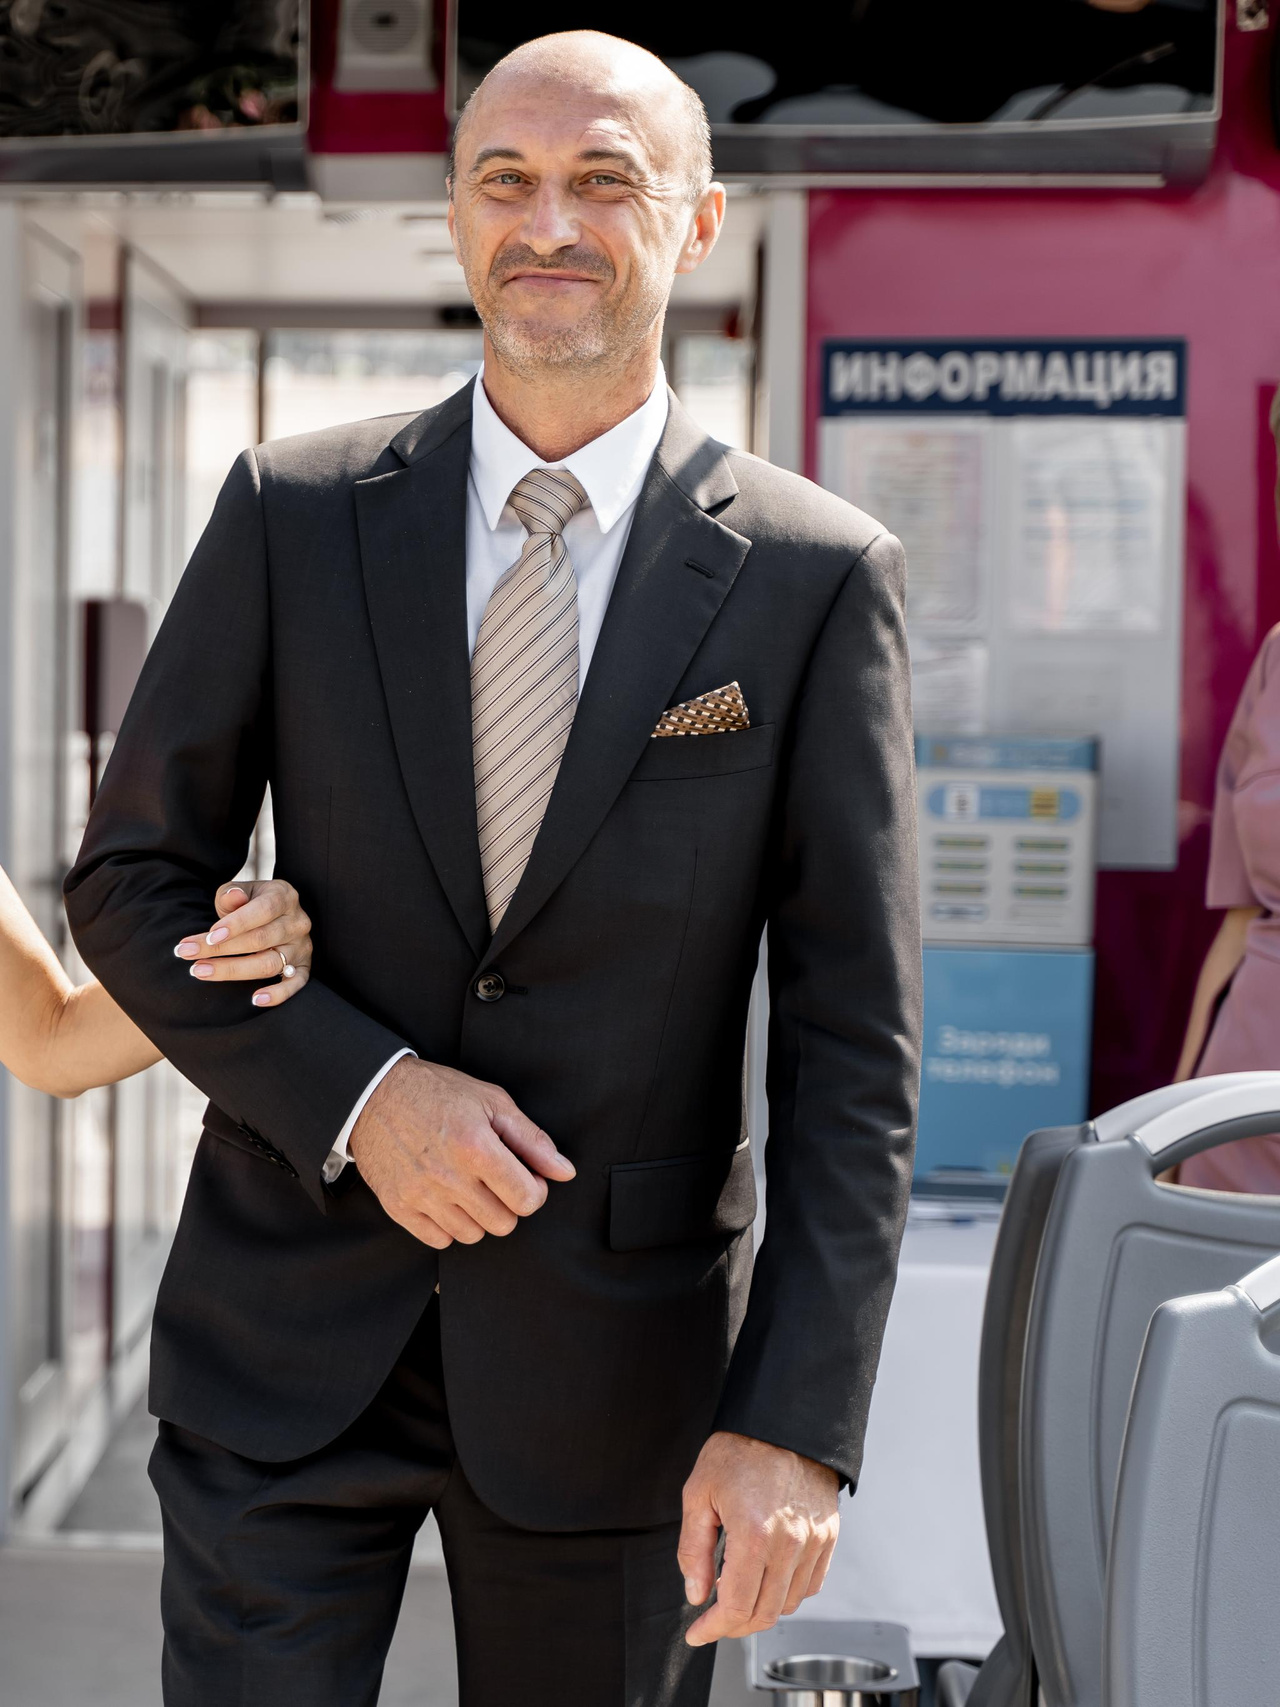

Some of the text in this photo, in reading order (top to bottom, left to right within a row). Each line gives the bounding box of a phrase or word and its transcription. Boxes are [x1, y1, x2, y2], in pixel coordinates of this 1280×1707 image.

[829, 350, 1177, 409] ИНФОРМАЦИЯ
[937, 1025, 1051, 1057] Заряди
[927, 1057, 1061, 1089] телефон
